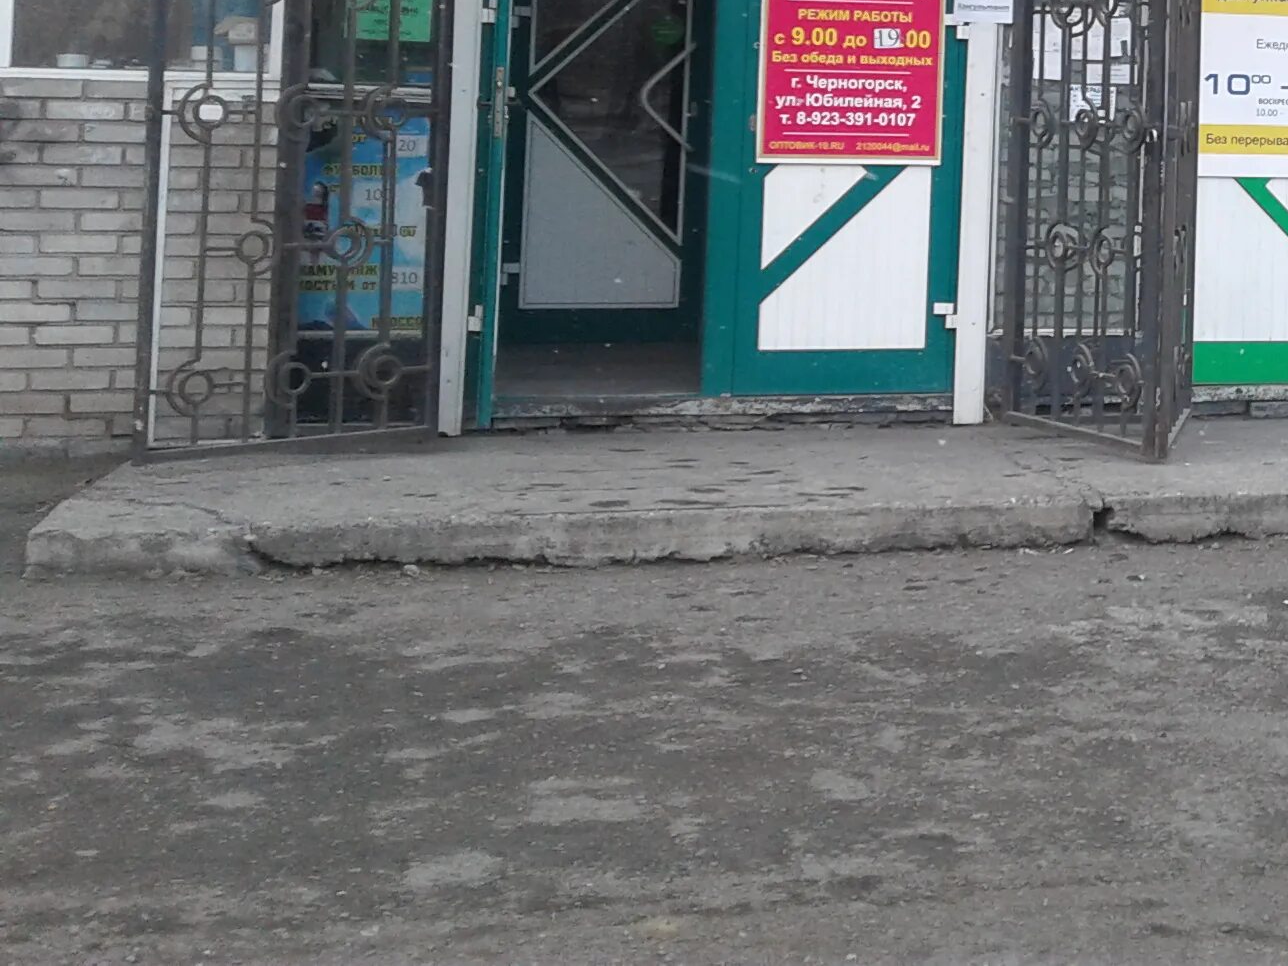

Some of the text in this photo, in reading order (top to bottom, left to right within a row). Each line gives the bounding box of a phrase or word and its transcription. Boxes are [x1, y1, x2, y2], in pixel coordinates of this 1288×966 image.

[797, 8, 912, 24] РЕЖИМ РАБОТЫ
[774, 33, 785, 45] с
[792, 27, 838, 46] 9.00
[843, 35, 867, 48] до
[771, 50, 933, 66] Без обеда и выходных
[791, 75, 908, 93] г. Черногорск,
[805, 93, 908, 111] Юбилейная,
[911, 95, 922, 109] 2
[780, 111, 916, 127] т. 8-923-391-0107
[1206, 134, 1227, 145] Без
